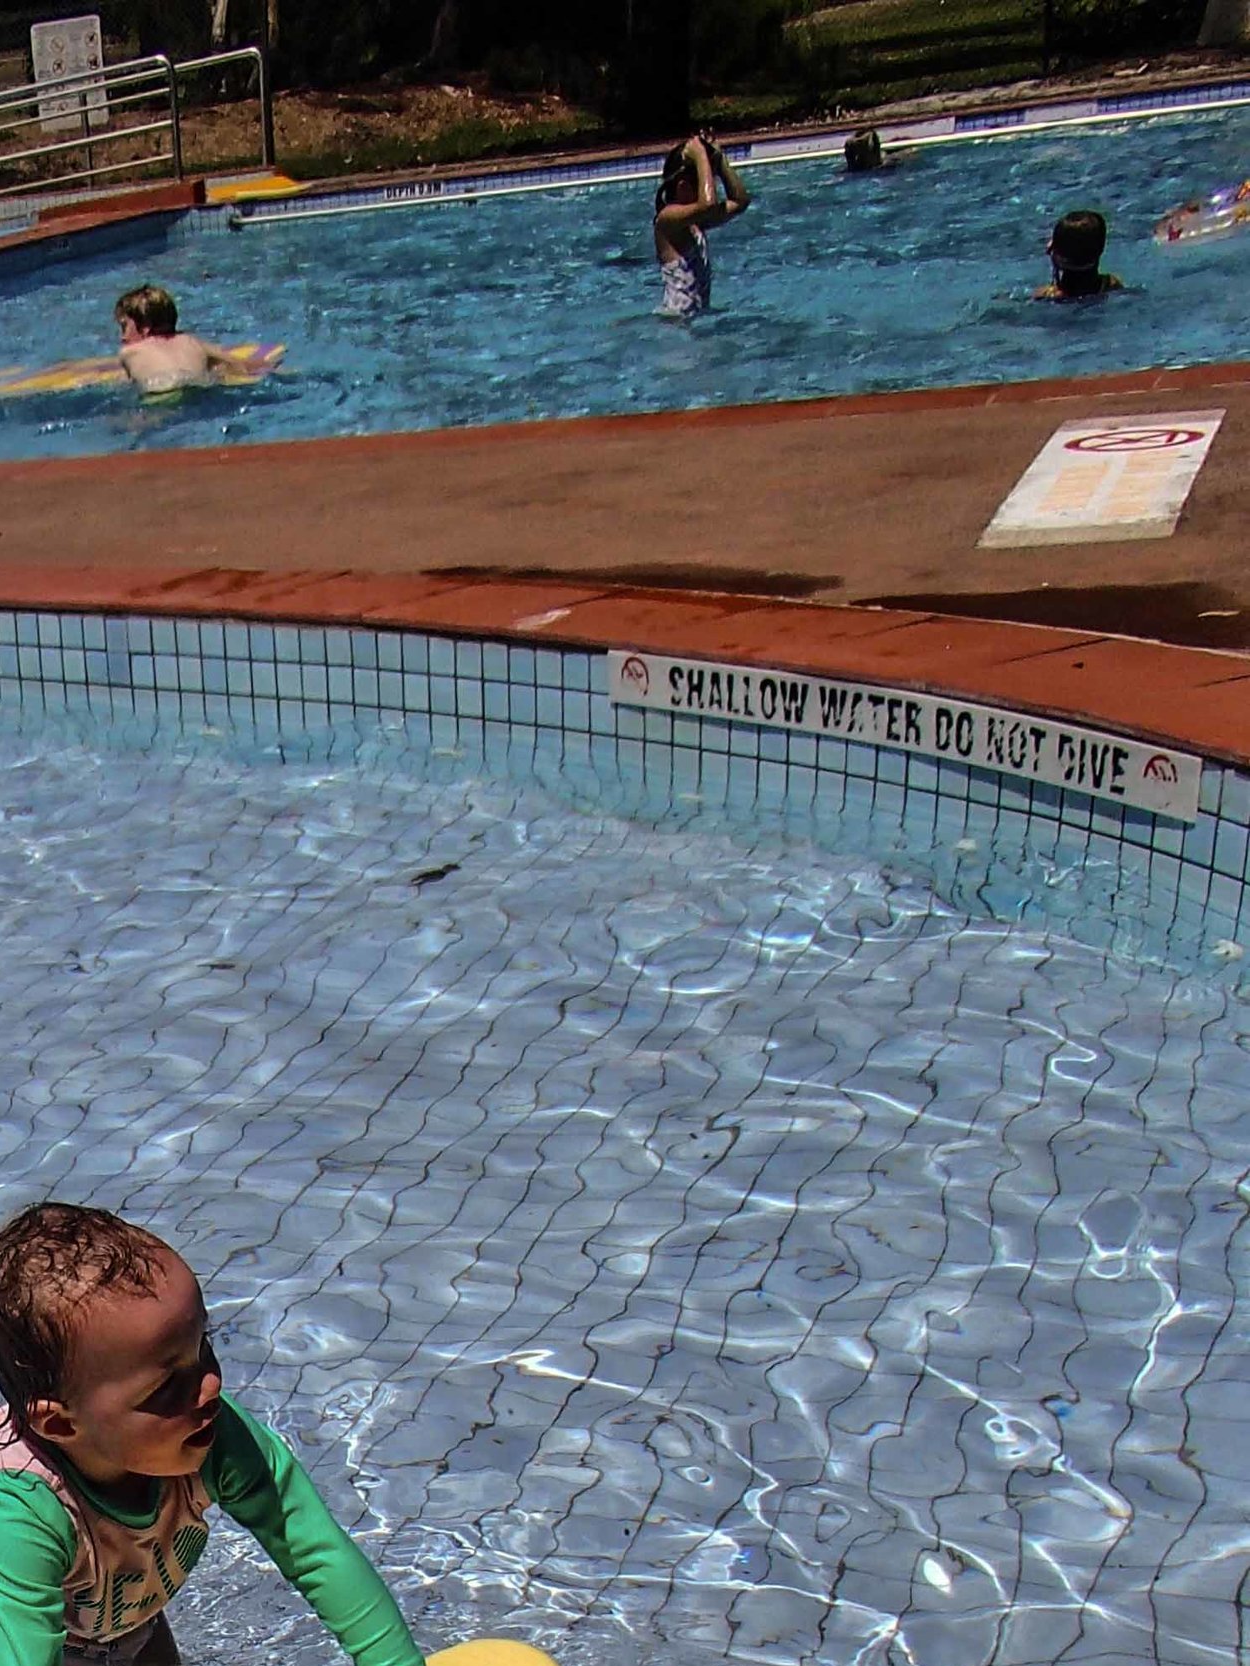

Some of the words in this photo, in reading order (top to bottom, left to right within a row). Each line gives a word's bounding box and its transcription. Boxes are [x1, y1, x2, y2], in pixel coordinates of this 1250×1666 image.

[668, 666, 809, 723] SHALLOW
[819, 686, 921, 746] WATER
[935, 708, 974, 757] DO
[987, 717, 1046, 772] NOT
[1058, 733, 1129, 794] DIVE
